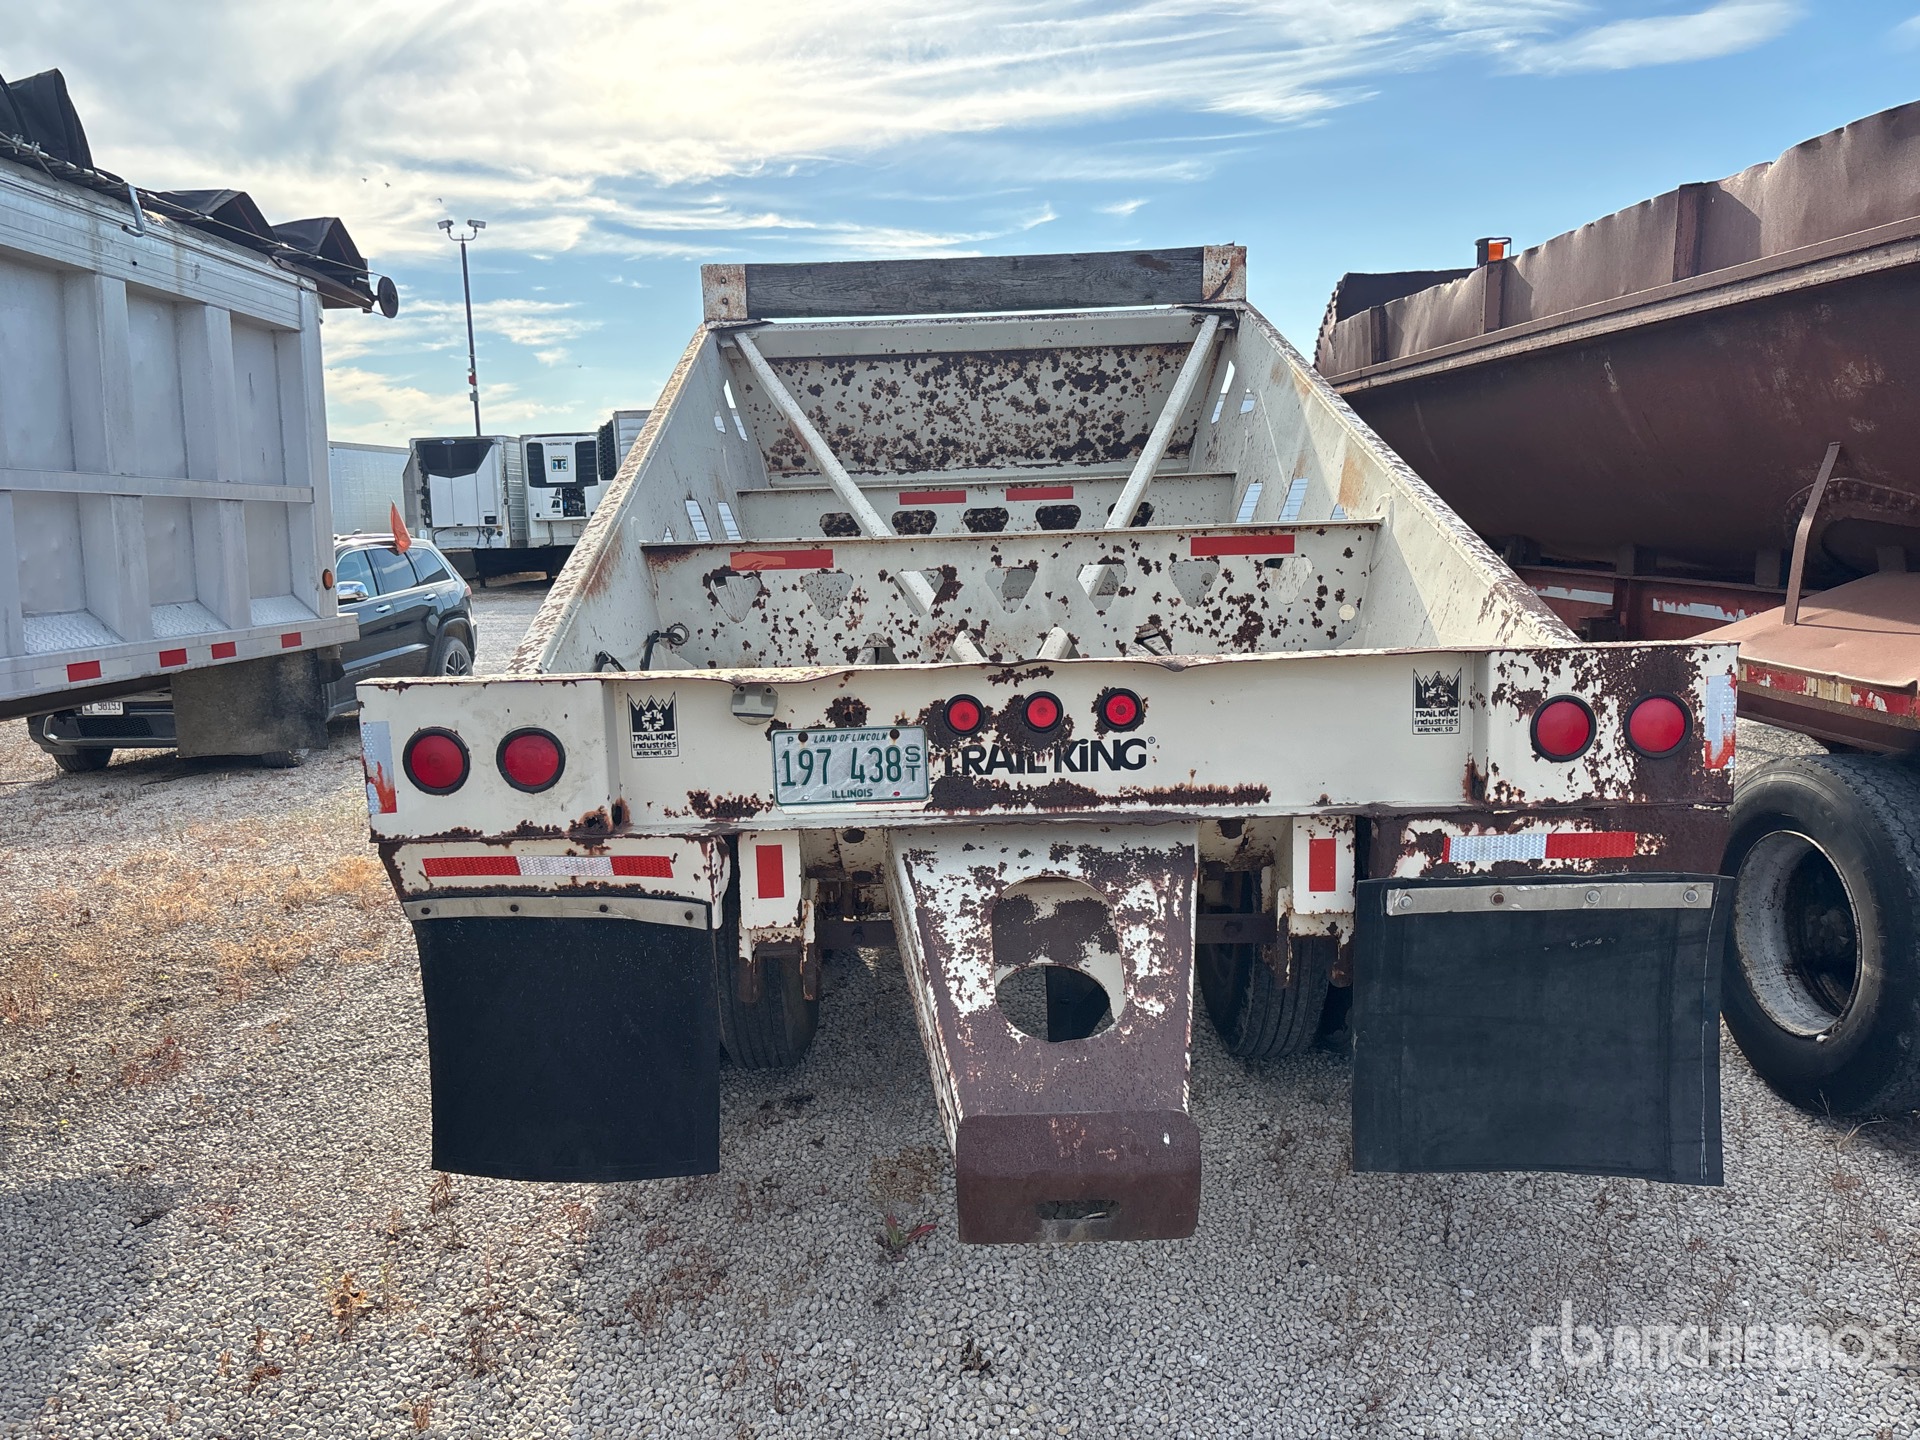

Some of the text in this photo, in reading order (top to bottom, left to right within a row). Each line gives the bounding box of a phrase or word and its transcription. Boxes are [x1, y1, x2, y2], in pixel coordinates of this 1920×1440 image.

[787, 736, 794, 744] P
[813, 732, 888, 744] LAND OF LINCOLN
[633, 741, 676, 749] industries
[781, 746, 902, 787] 197 438
[831, 788, 874, 799] ILLINOIS
